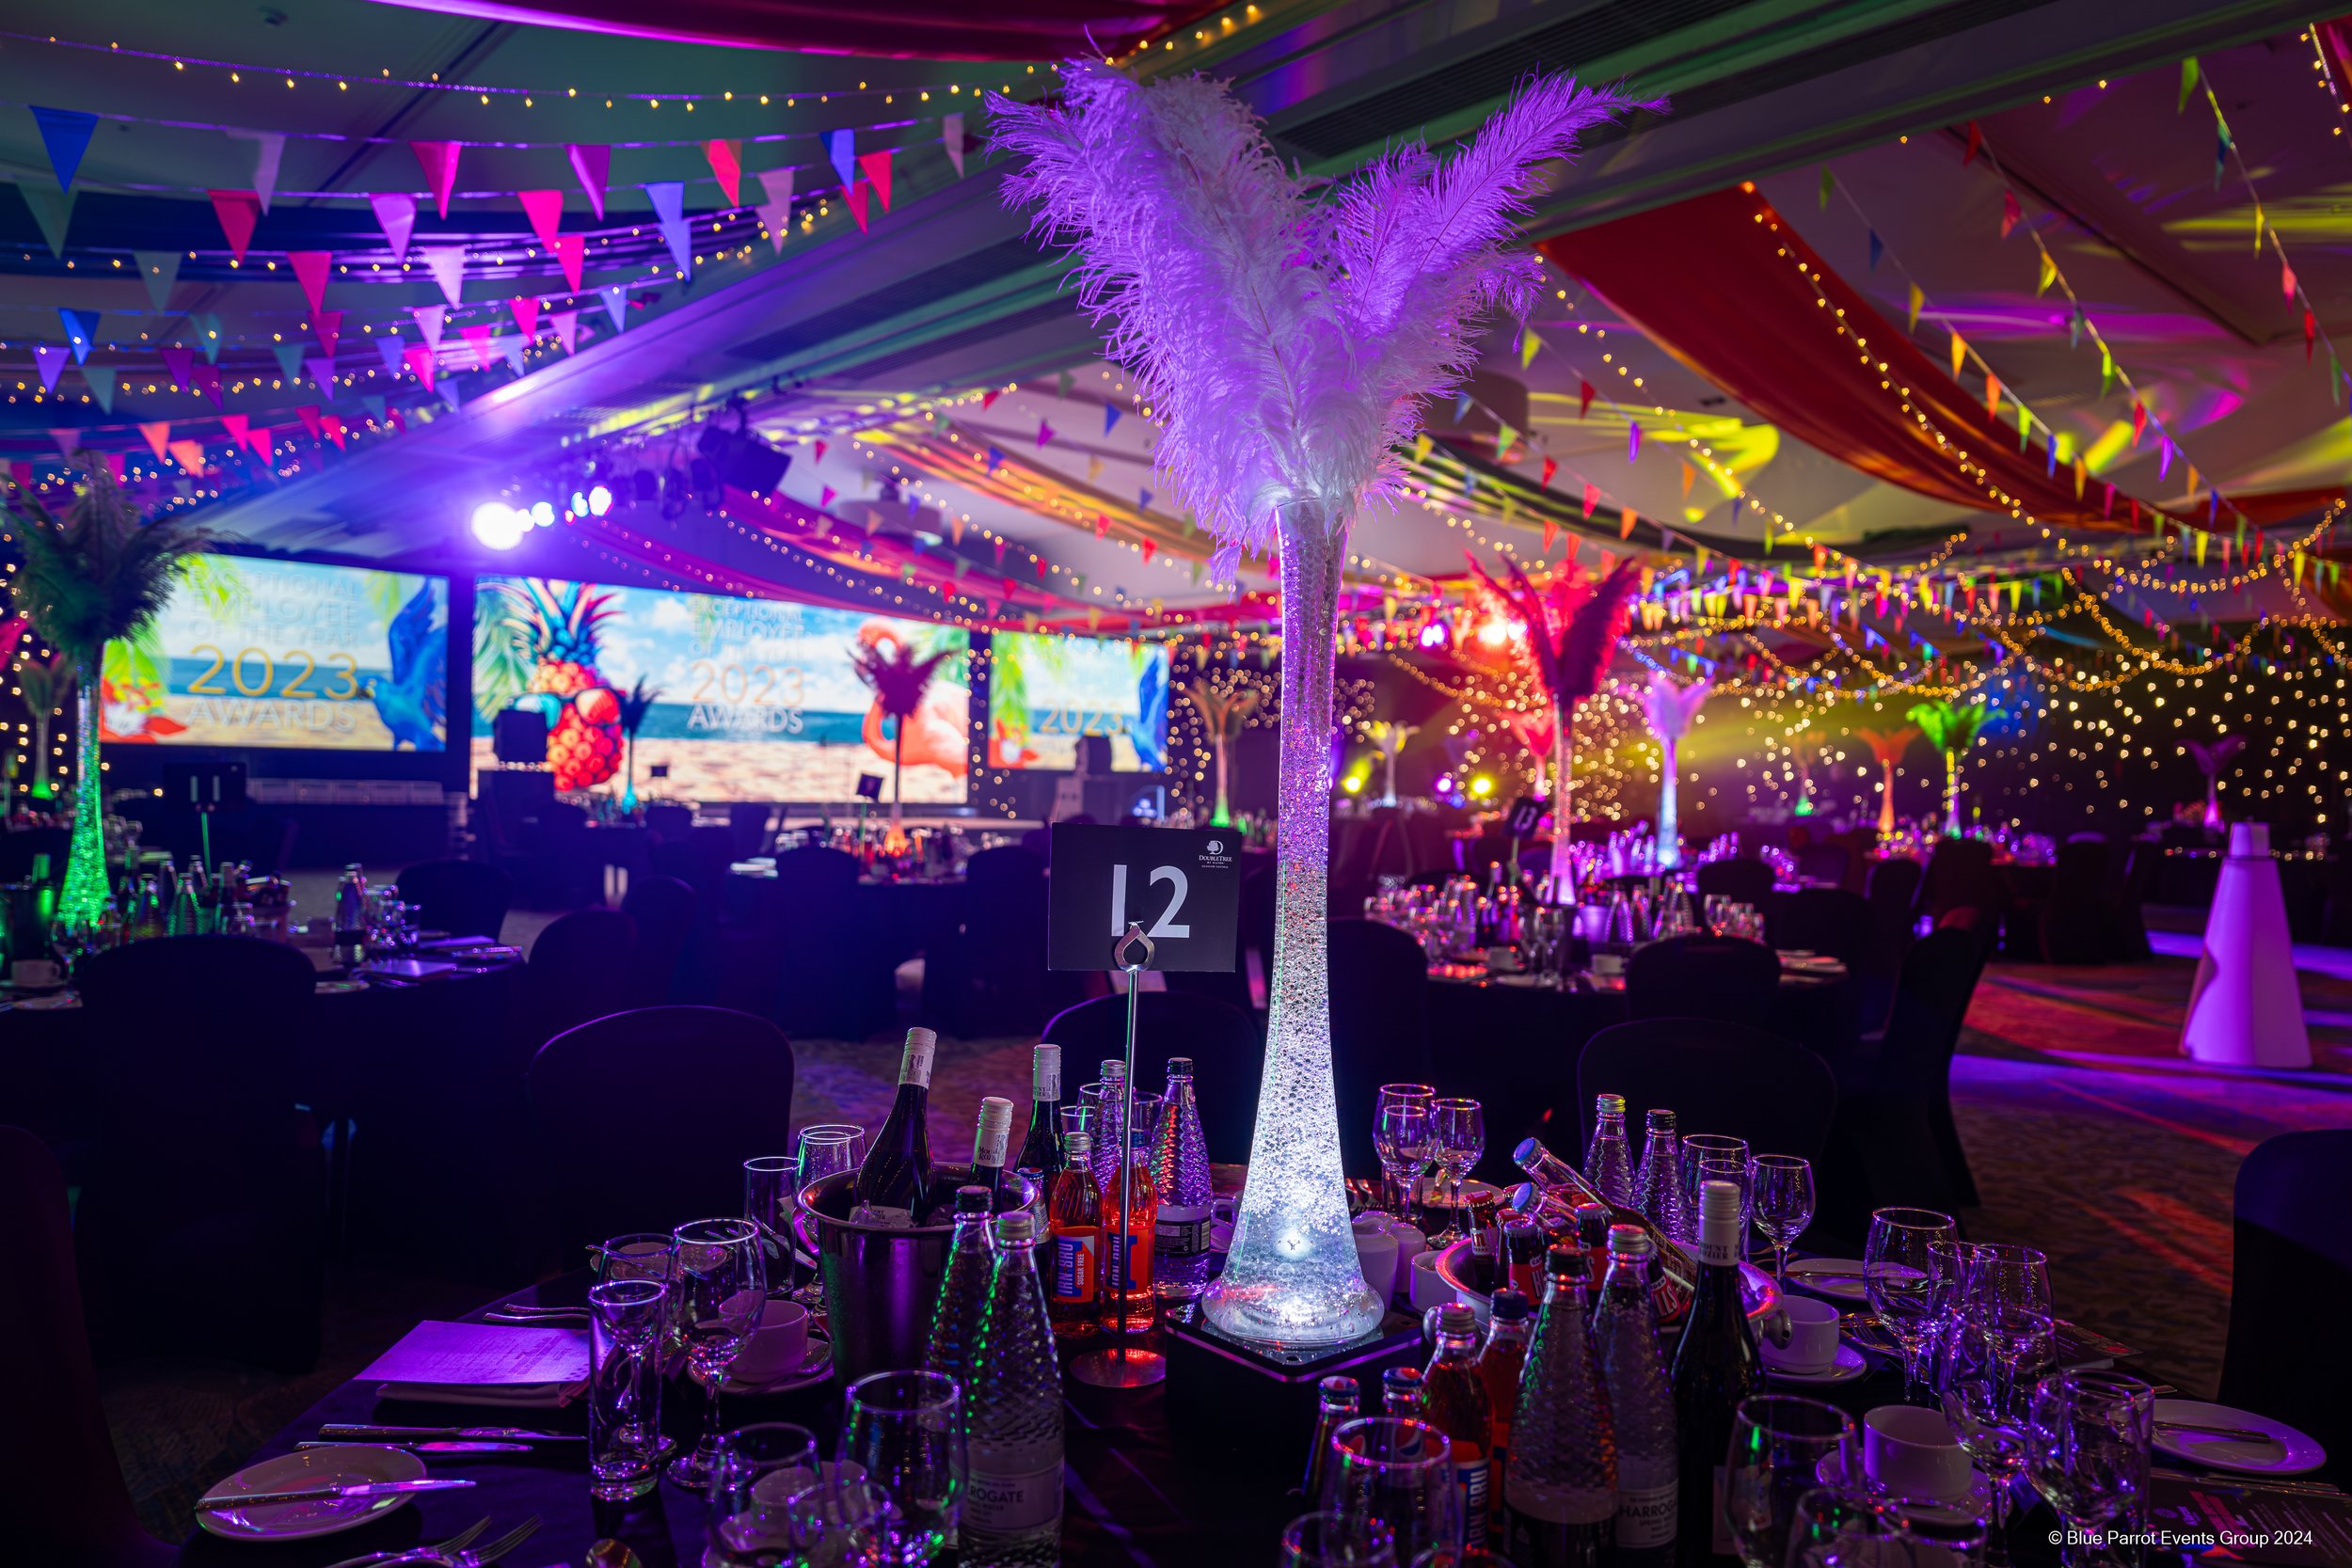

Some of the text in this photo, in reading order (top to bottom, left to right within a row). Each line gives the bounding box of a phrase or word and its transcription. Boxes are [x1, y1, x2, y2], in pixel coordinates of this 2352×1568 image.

[190, 589, 359, 626] EMPLOYEE
[188, 643, 358, 700] 2023
[691, 660, 804, 709] 2023
[187, 696, 357, 733] AWARDS
[687, 703, 803, 734] AWARDS
[1040, 698, 1123, 736] 2023
[1111, 863, 1190, 939] 12
[1654, 1286, 1678, 1318] LLS
[970, 1485, 1024, 1503] ROGATE
